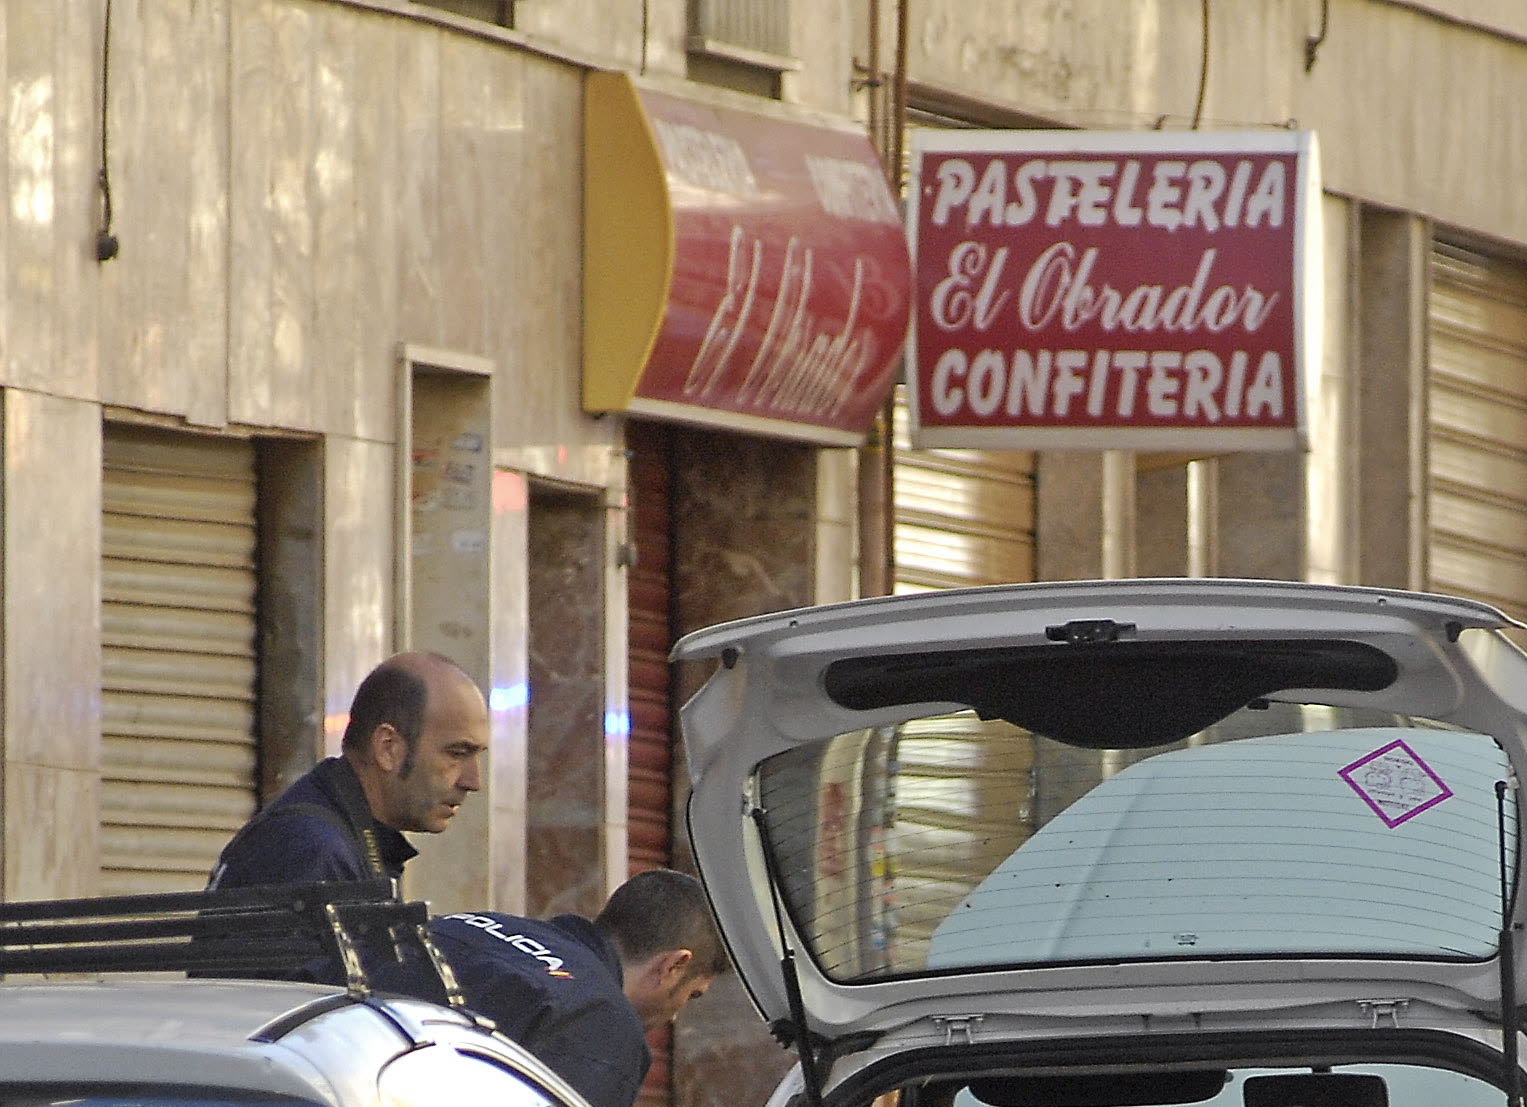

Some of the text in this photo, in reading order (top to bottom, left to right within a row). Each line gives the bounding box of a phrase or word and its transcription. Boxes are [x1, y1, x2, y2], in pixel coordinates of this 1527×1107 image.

[931, 158, 1286, 232] PASTELERIA
[931, 240, 1280, 332] El Obrador
[931, 347, 1284, 422] CONFITERIA
